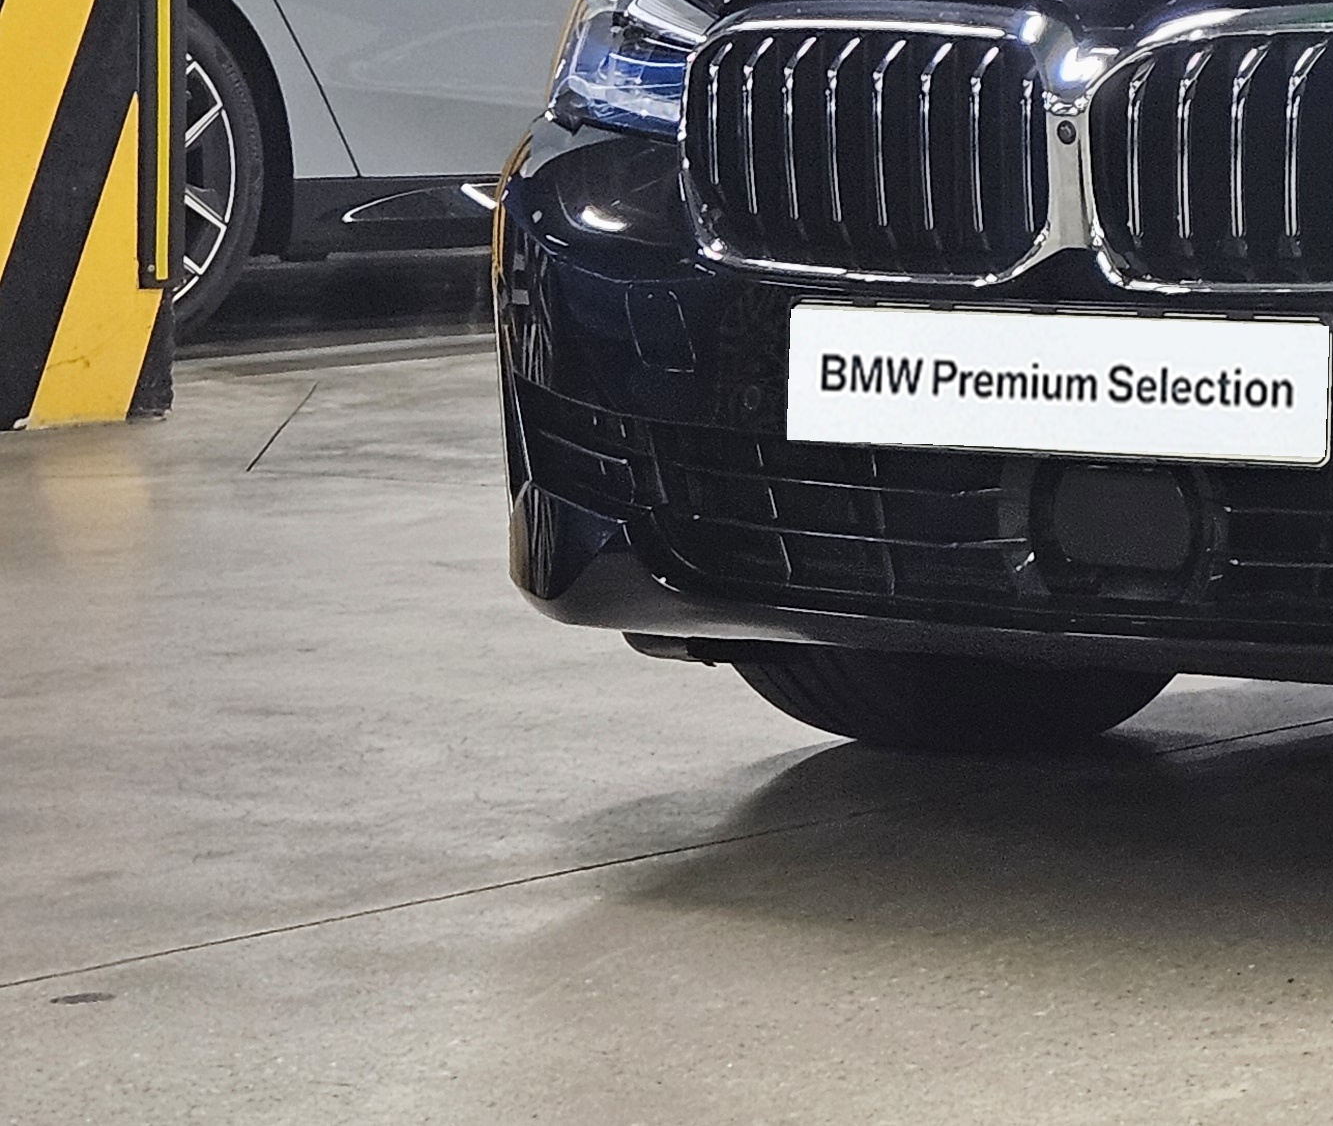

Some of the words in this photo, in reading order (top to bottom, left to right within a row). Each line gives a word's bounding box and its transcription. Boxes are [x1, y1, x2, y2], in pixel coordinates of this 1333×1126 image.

[818, 352, 923, 396] BMW
[930, 358, 1099, 404] Premium
[1107, 364, 1296, 409] Selection
